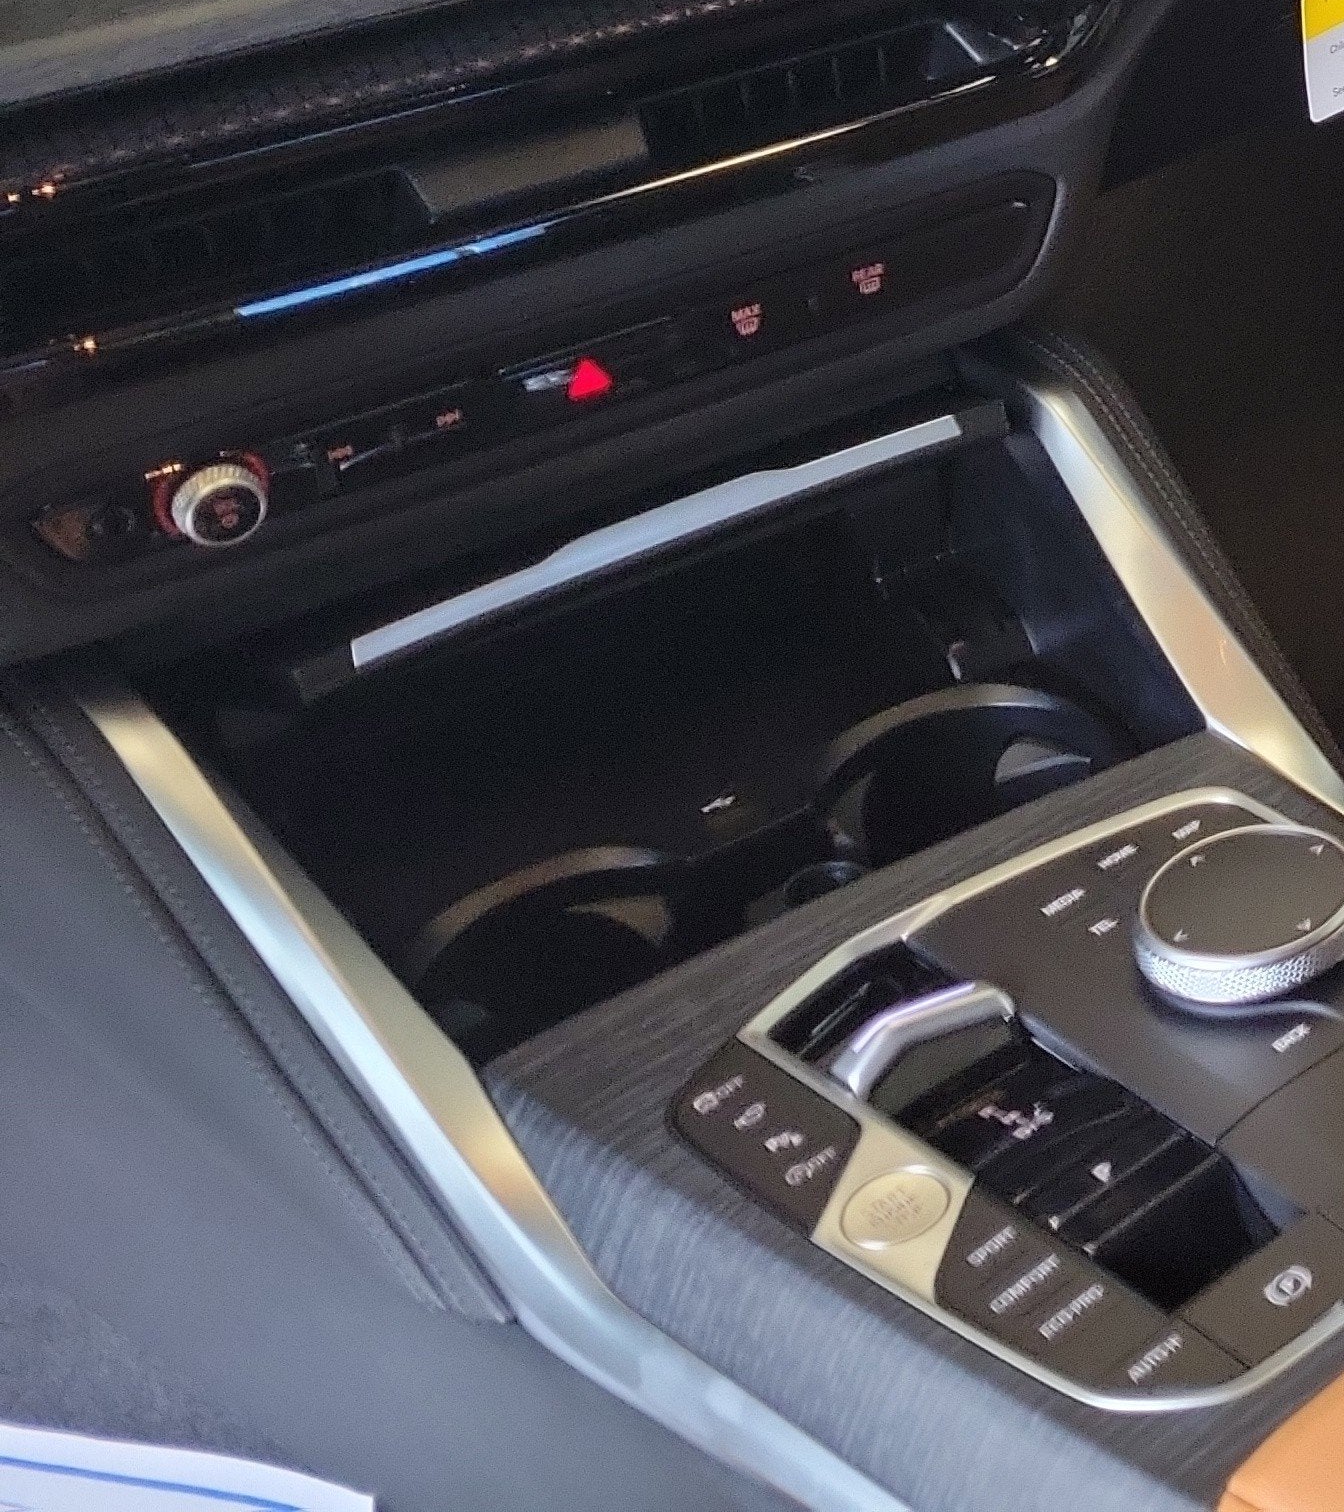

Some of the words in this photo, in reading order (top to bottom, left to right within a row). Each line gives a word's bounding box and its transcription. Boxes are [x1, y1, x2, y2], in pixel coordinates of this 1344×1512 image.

[1271, 1021, 1312, 1053] BACK
[966, 1225, 1017, 1268] SPORT
[990, 1253, 1061, 1315] COMFORT
